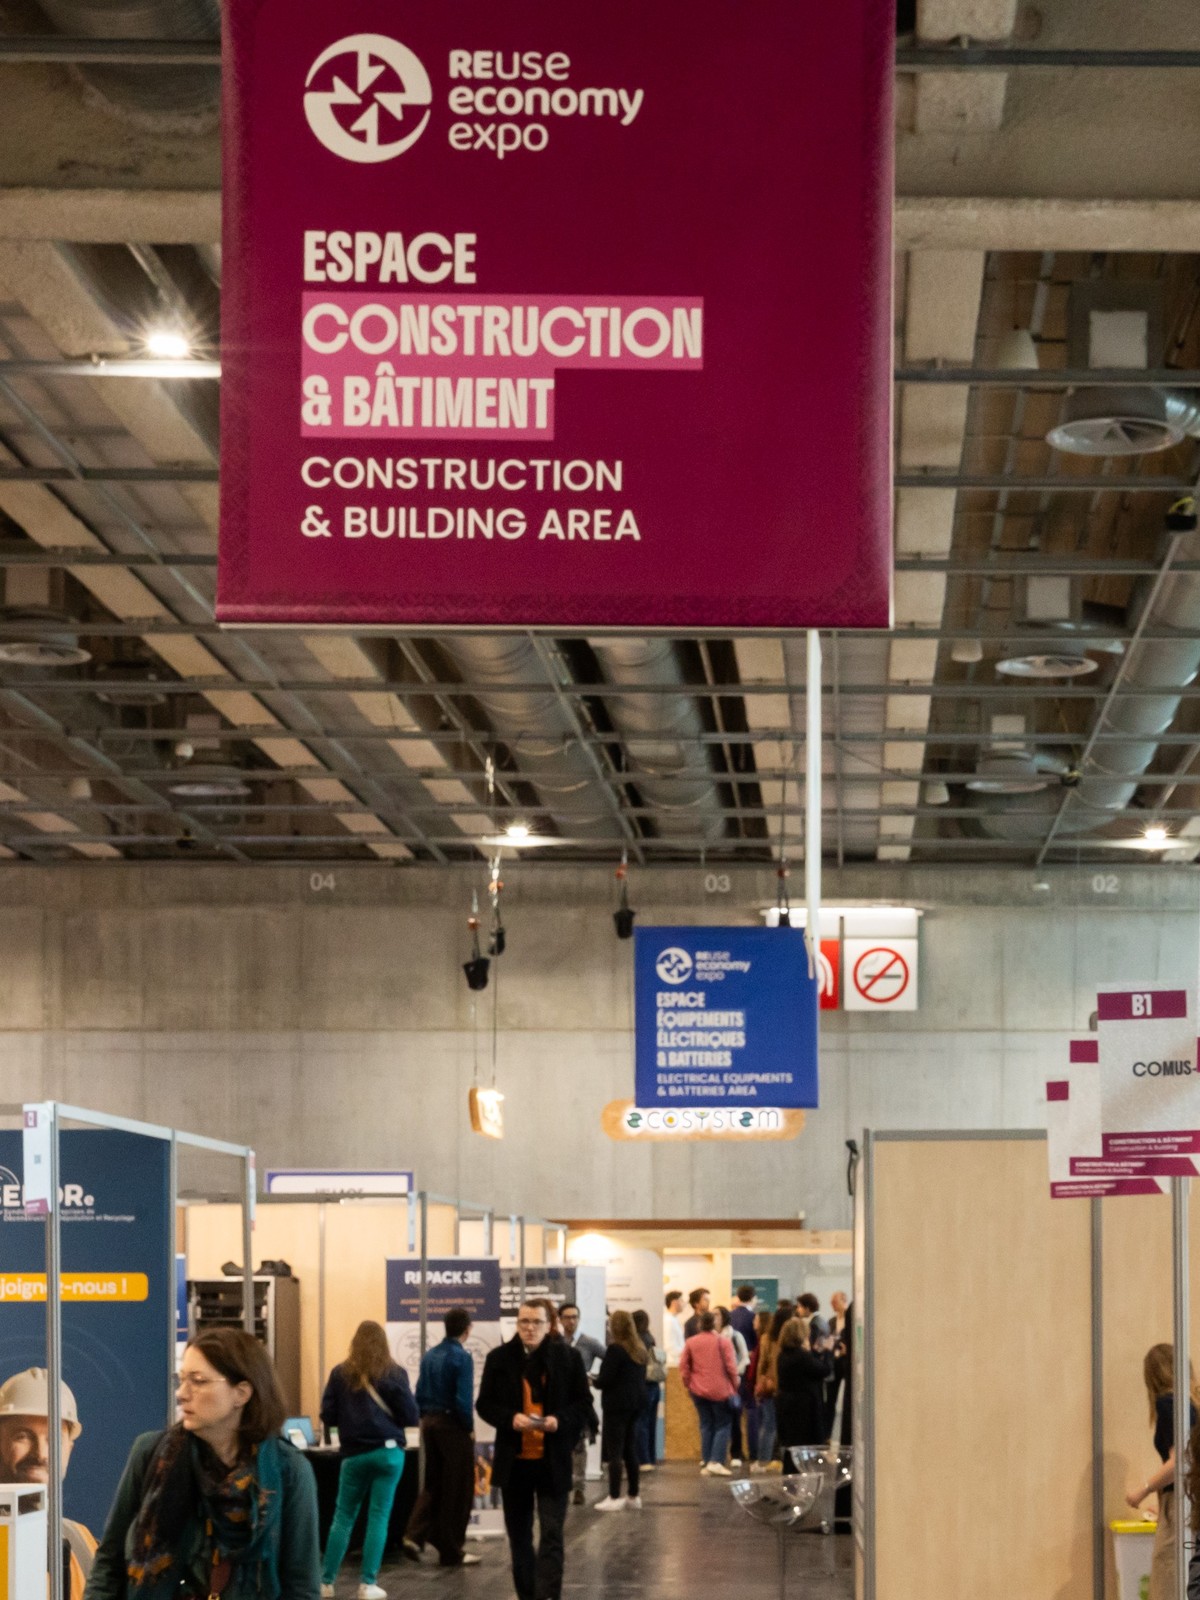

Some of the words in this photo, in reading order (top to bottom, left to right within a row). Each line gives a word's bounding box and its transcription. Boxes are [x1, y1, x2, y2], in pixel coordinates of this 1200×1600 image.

[449, 50, 571, 80] REuse
[449, 87, 644, 126] economy
[449, 121, 549, 159] expo
[304, 231, 477, 284] ESPACE
[302, 302, 702, 359] CONSTRUCTION
[302, 375, 332, 427] &
[344, 361, 555, 429] BÂTIMENT
[301, 456, 623, 491] CONSTRUCTION
[300, 505, 332, 538] &
[344, 506, 527, 540] BUILDING
[538, 509, 641, 541] AREA
[310, 872, 336, 891] 04
[705, 874, 731, 892] 03
[1092, 874, 1119, 893] 02
[695, 961, 751, 973] economy
[695, 971, 725, 982] expo
[656, 992, 706, 1008] ESPACE
[1131, 993, 1152, 1016] B1
[656, 1009, 744, 1030] ÉQUIPEMENTS
[656, 1028, 746, 1050] ÉLECTRIQUES
[668, 1051, 732, 1067] BATTERIES
[656, 1073, 721, 1084] ELECTRICAL
[723, 1073, 793, 1084] EQUIPMENTS
[656, 1085, 667, 1096] &
[668, 1085, 726, 1096] BATTERIES
[727, 1085, 758, 1096] AREA
